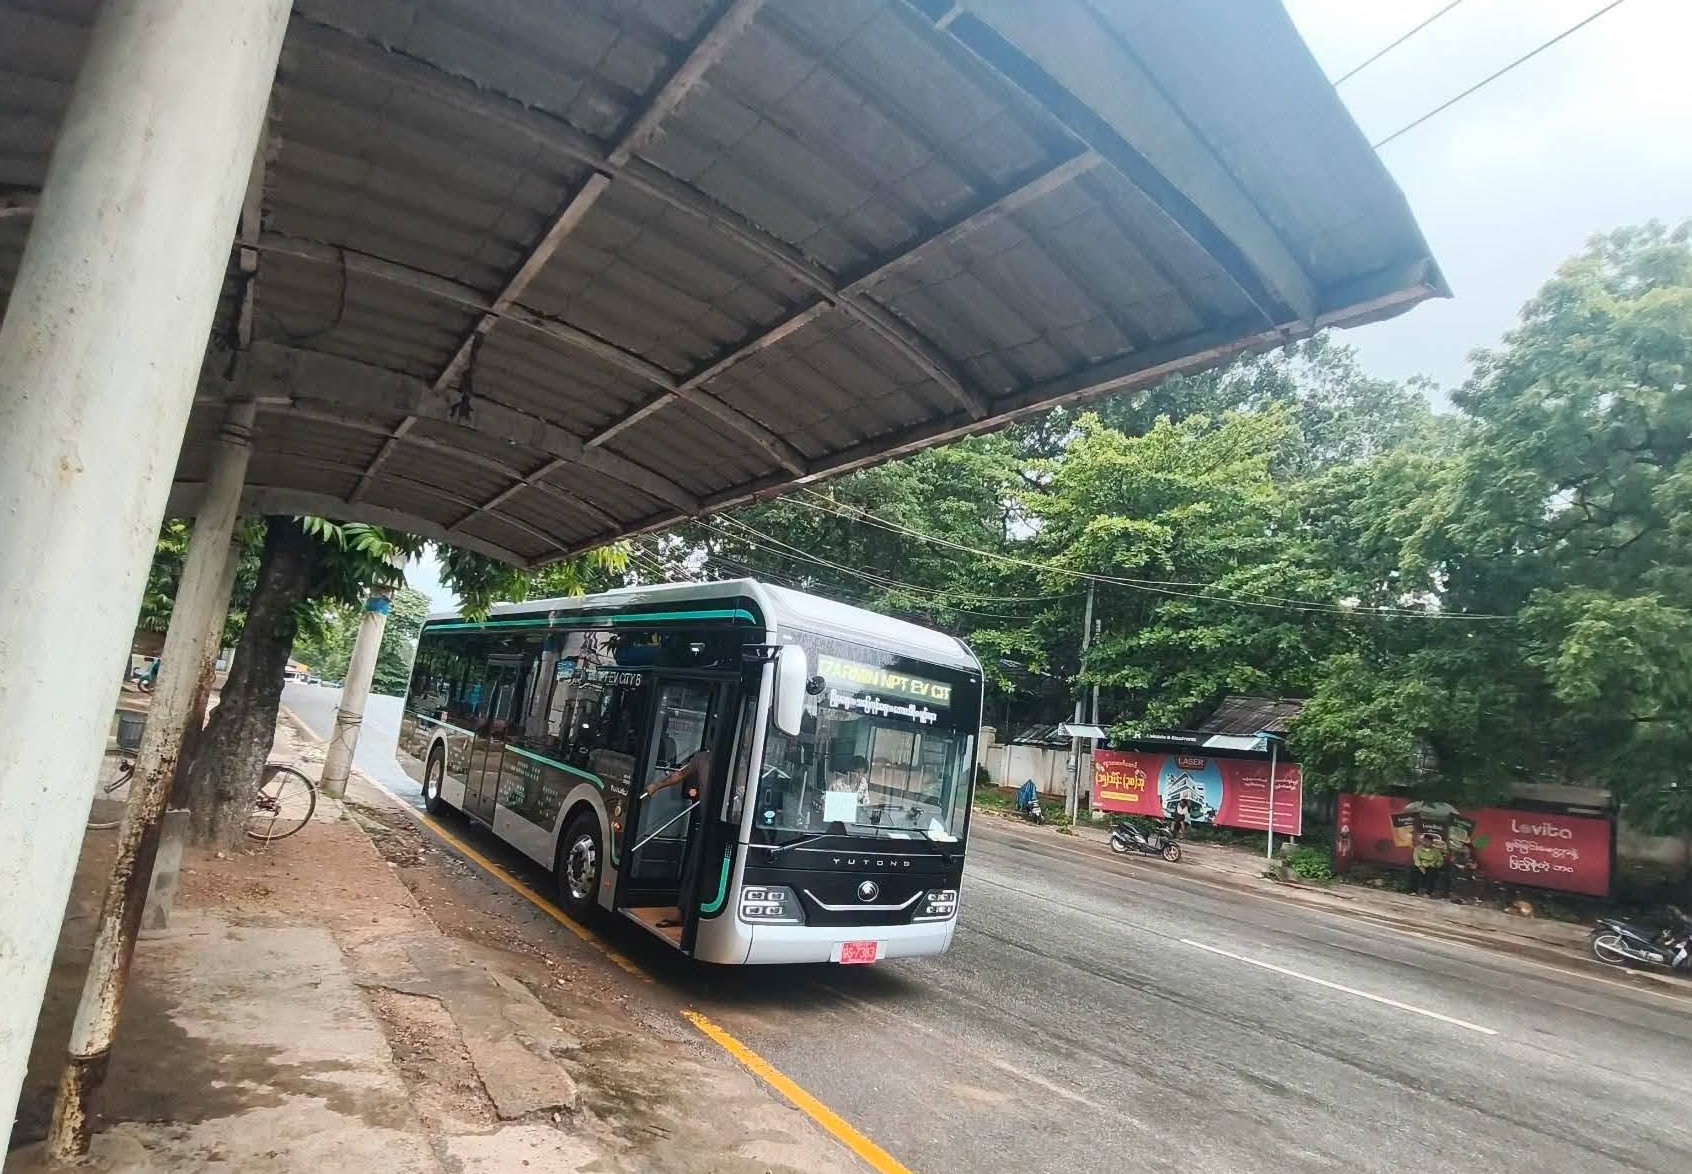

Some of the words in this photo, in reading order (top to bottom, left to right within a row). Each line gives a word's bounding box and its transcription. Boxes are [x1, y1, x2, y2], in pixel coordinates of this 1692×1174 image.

[1178, 757, 1205, 766] LASER
[1511, 818, 1573, 840] Lovita
[833, 858, 910, 868] YUTONG
